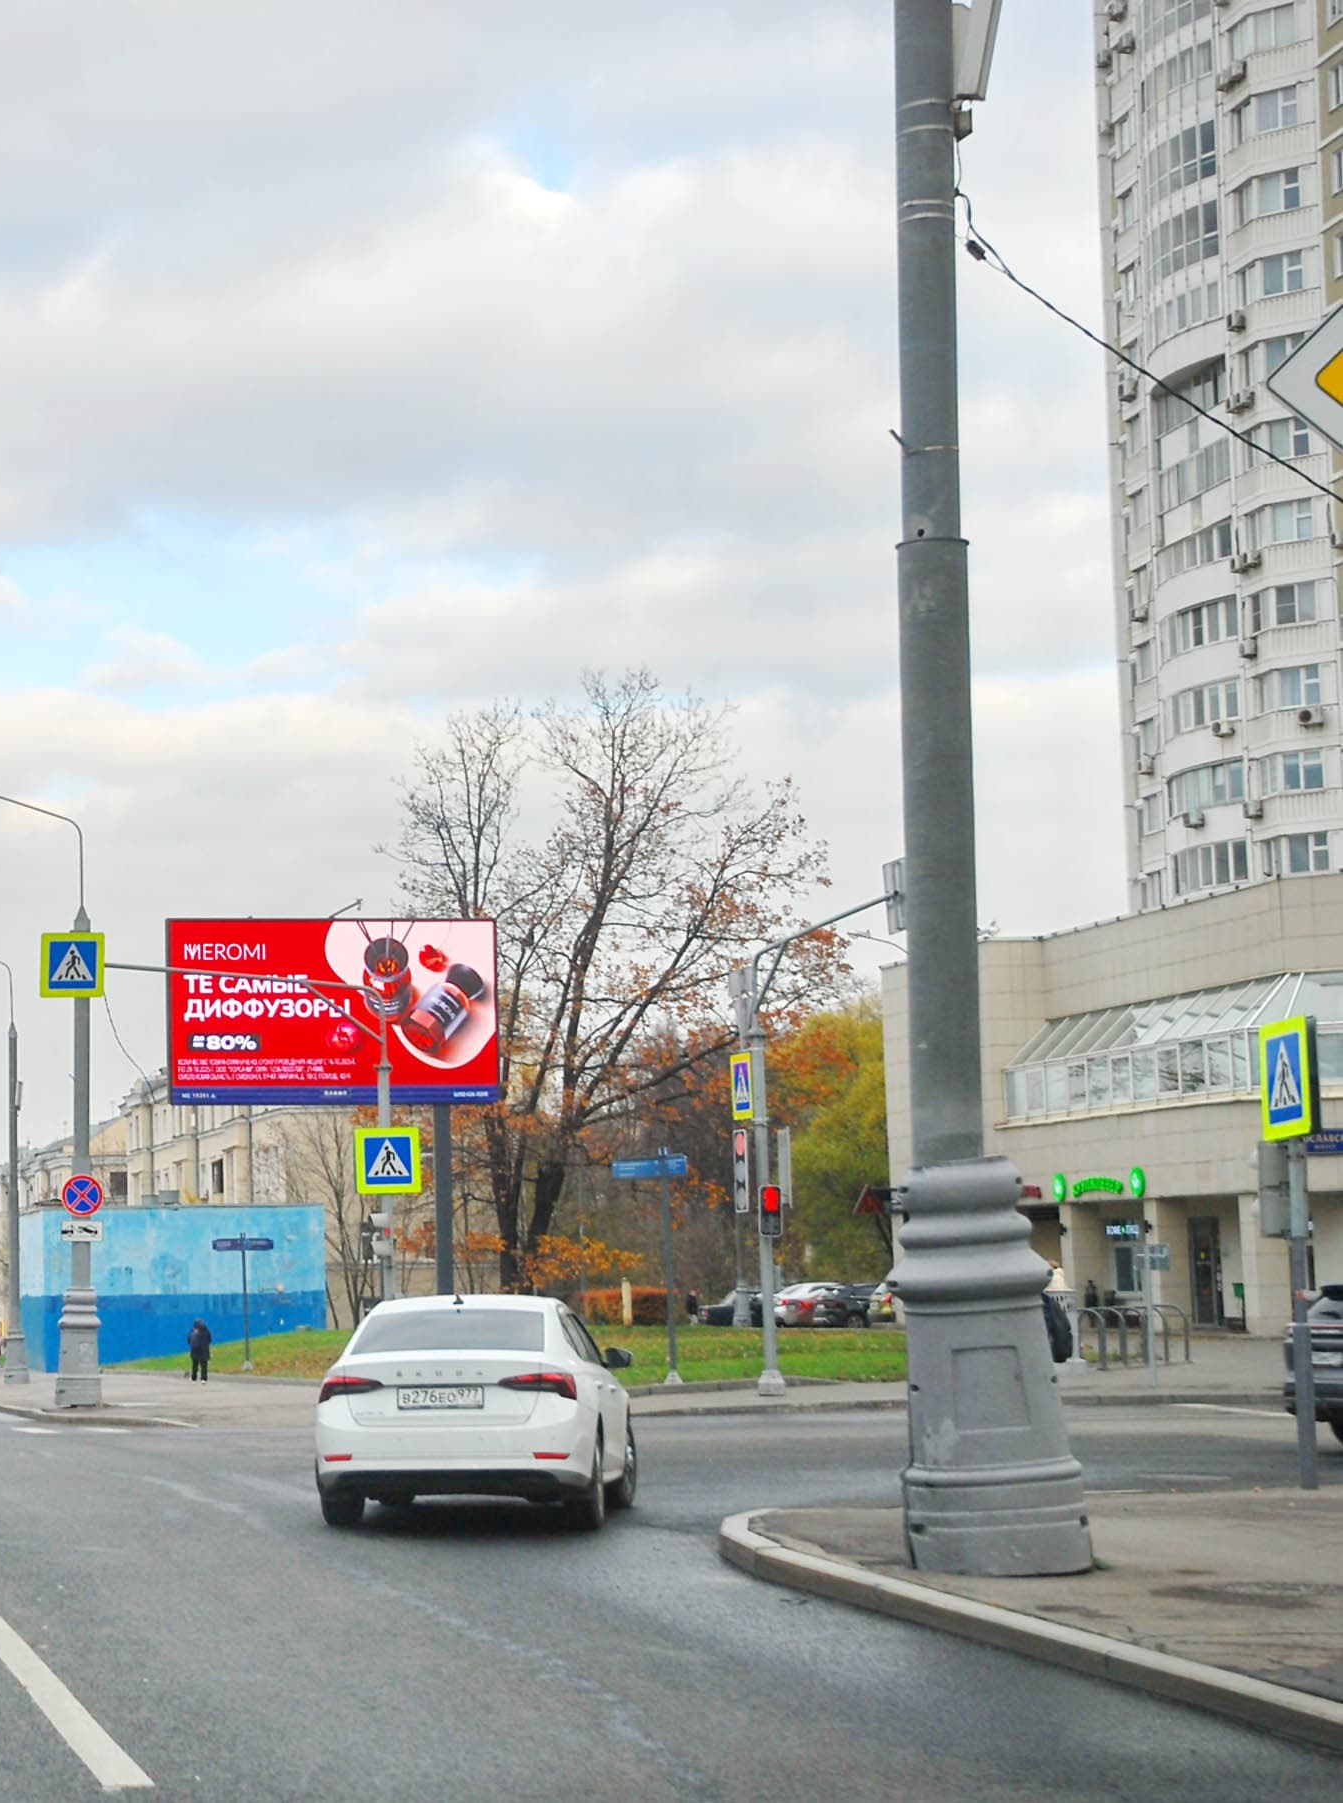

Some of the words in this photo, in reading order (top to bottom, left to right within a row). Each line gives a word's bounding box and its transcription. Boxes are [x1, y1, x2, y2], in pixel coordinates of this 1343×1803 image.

[183, 943, 267, 961] MEROMI
[183, 973, 213, 994] ТЕ
[219, 973, 309, 994] САМЫЕ
[183, 998, 351, 1022] ДИФФУЗОРЫ
